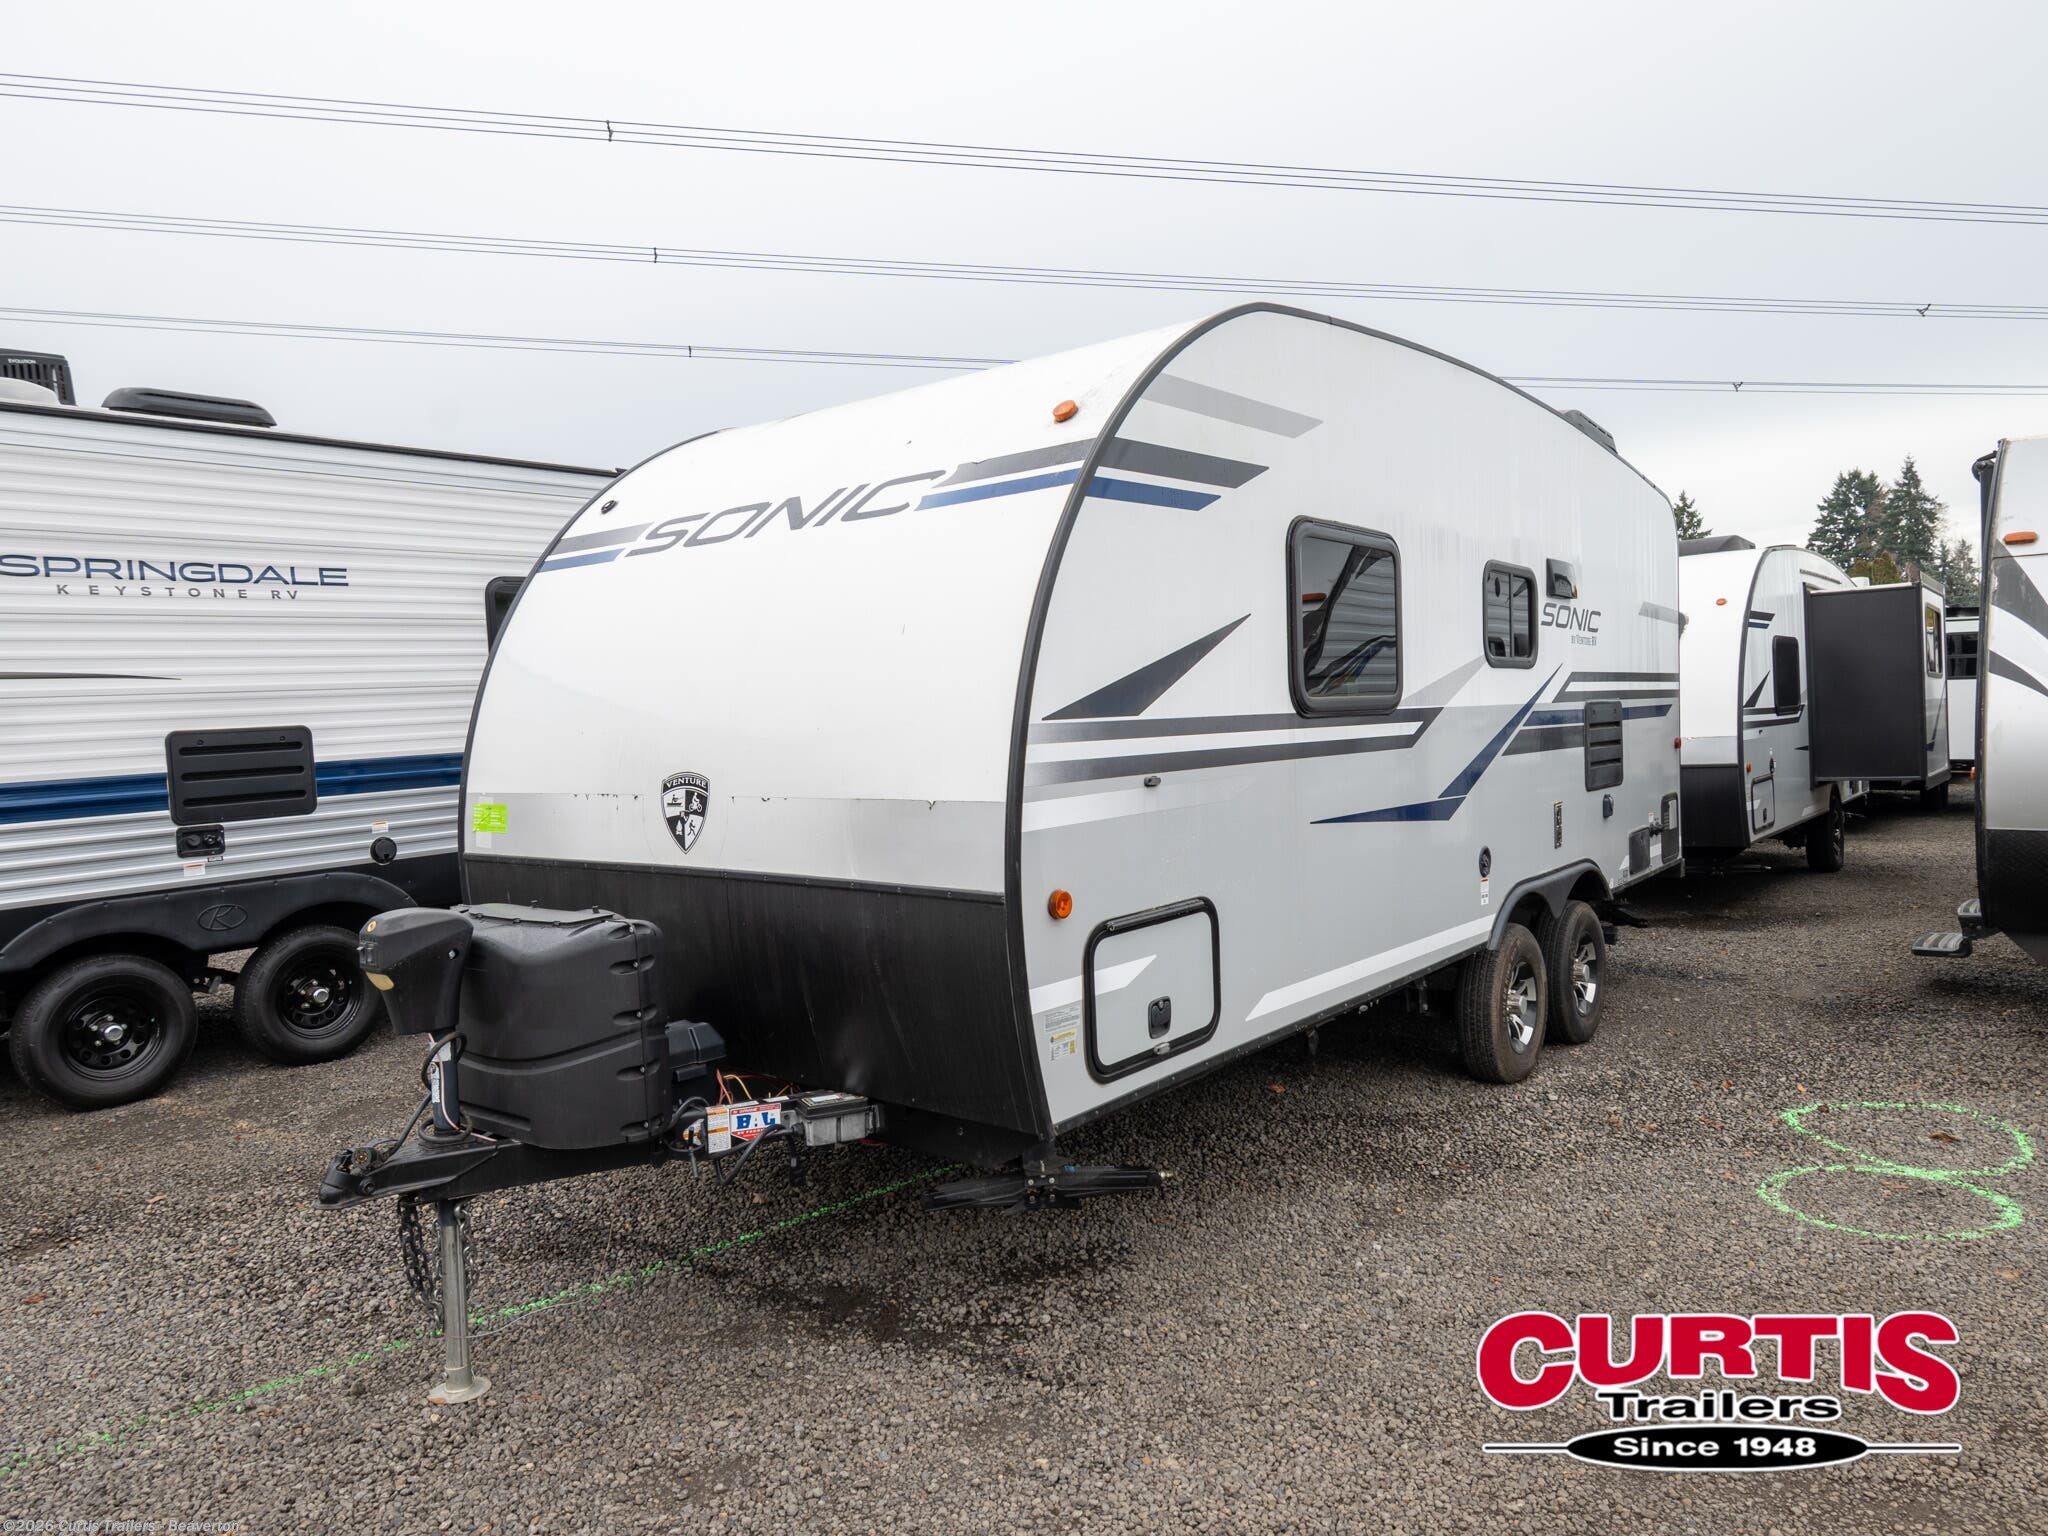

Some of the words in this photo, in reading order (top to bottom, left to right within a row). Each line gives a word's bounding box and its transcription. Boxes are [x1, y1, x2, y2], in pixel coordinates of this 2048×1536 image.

[625, 469, 947, 558] SONIC
[0, 554, 349, 587] SPRINGDALE
[56, 584, 248, 599] KEYSTONE
[271, 589, 299, 603] RV
[541, 602, 601, 633] SONIC
[666, 777, 707, 788] VENTURE
